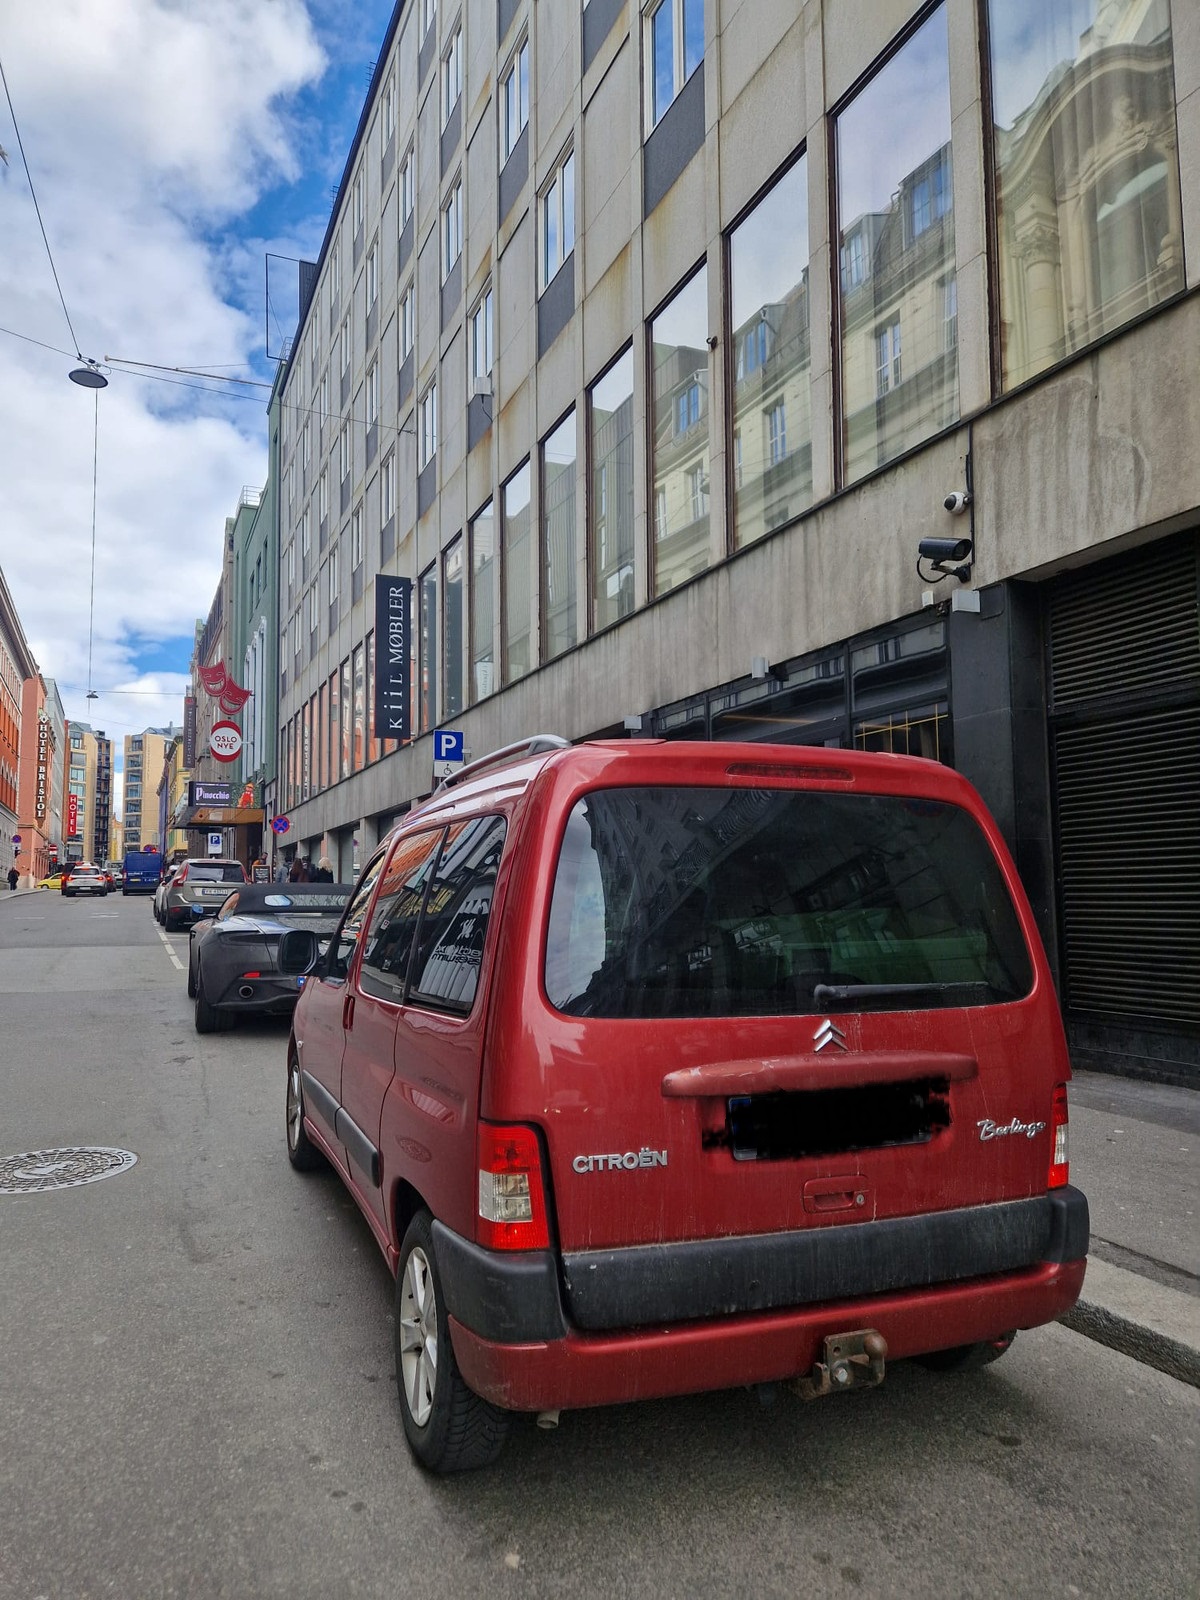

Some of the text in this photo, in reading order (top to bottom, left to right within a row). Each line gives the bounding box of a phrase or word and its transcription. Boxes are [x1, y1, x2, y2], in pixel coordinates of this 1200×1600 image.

[388, 586, 404, 665] MØBLER
[214, 735, 238, 743] OSLO
[217, 742, 234, 750] NYE
[441, 734, 457, 757] P
[37, 724, 47, 817] HOTEL BRISTOL
[195, 787, 230, 801] Pinocchio
[69, 796, 77, 833] HOTEL
[212, 836, 218, 844] P
[976, 1117, 1046, 1141] Berlingo
[572, 1146, 668, 1174] CITROËN
